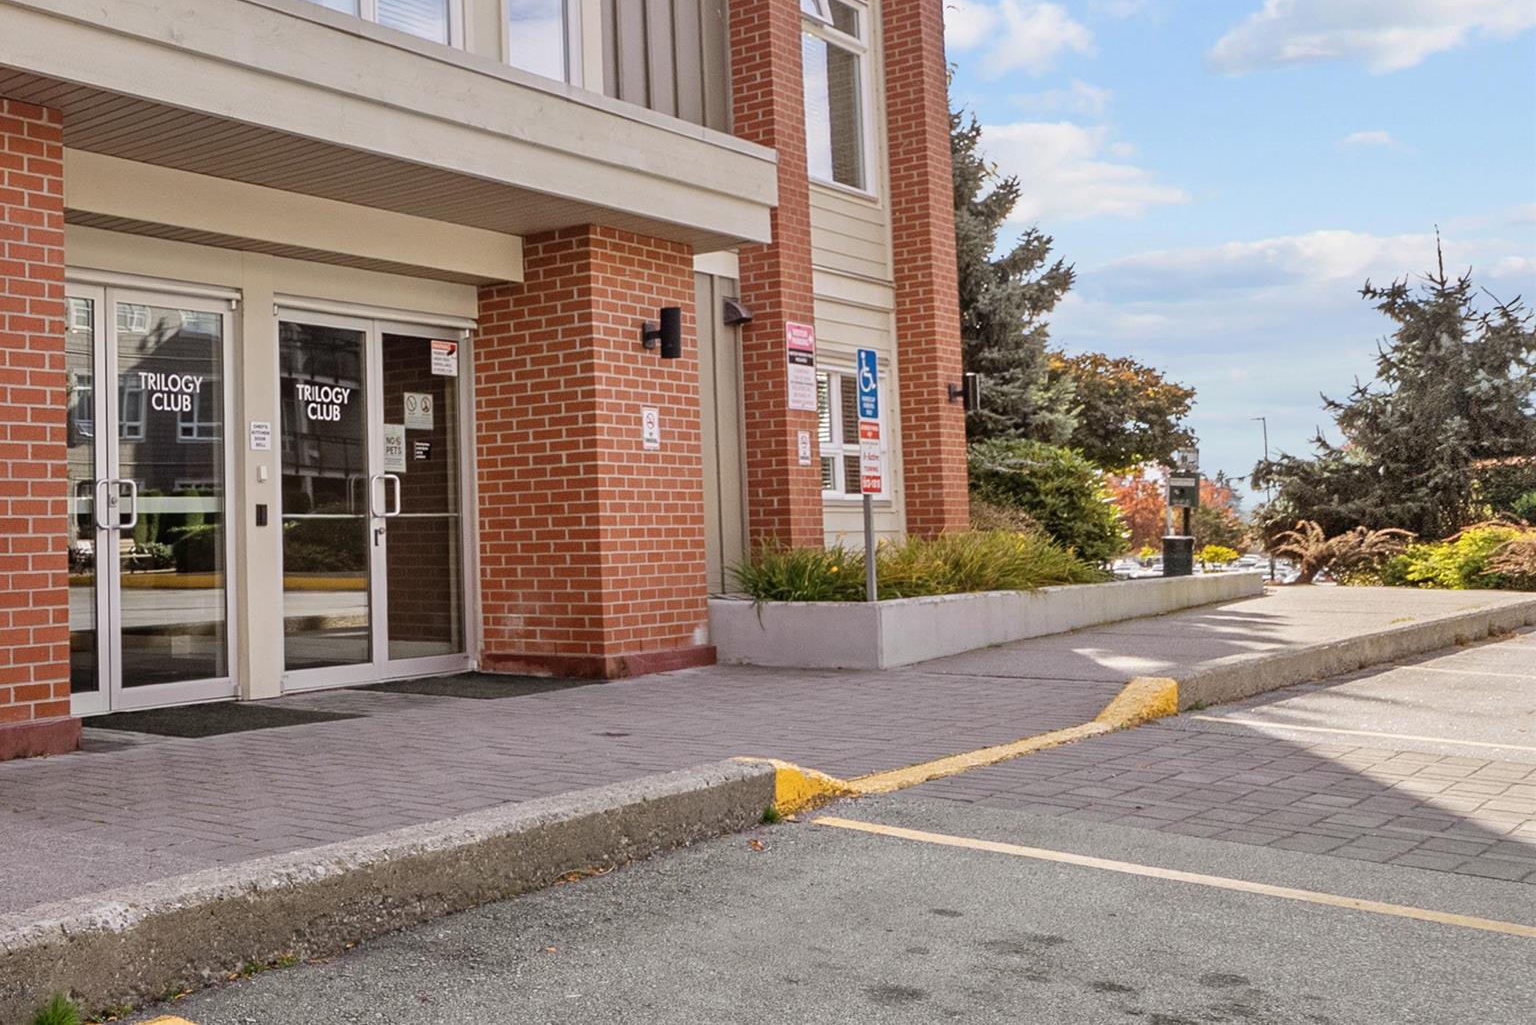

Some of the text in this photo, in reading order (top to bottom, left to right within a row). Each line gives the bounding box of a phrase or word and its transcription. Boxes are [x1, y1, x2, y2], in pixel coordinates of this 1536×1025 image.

[138, 372, 204, 394] TRILOGY
[151, 392, 192, 412] CLUB
[296, 384, 351, 405] TRILOGY
[307, 403, 341, 421] CLUB
[385, 436, 395, 445] NO
[385, 446, 402, 455] PETS
